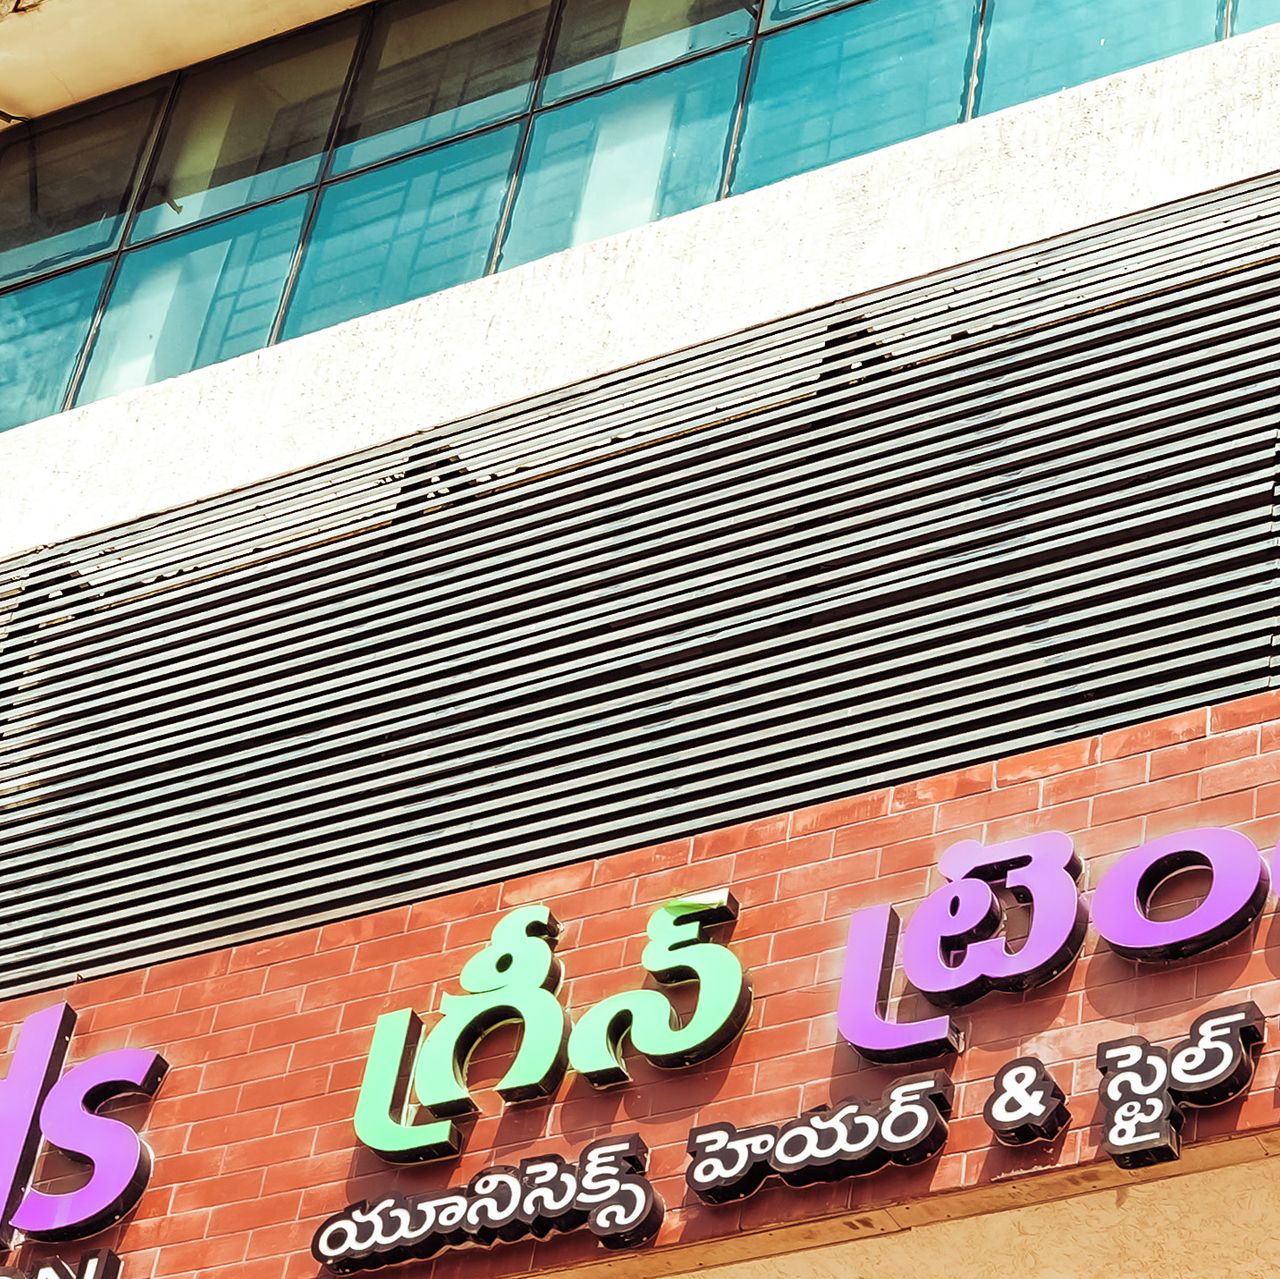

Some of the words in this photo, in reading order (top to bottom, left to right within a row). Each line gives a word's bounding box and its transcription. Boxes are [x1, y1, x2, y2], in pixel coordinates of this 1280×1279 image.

[317, 1142, 647, 1257] యూనిసెక్స్
[693, 1080, 936, 1184] హెయర్
[991, 1065, 1047, 1123] &
[1105, 1012, 1247, 1147] స్టైల్
[354, 888, 742, 1154] గ్రీన్
